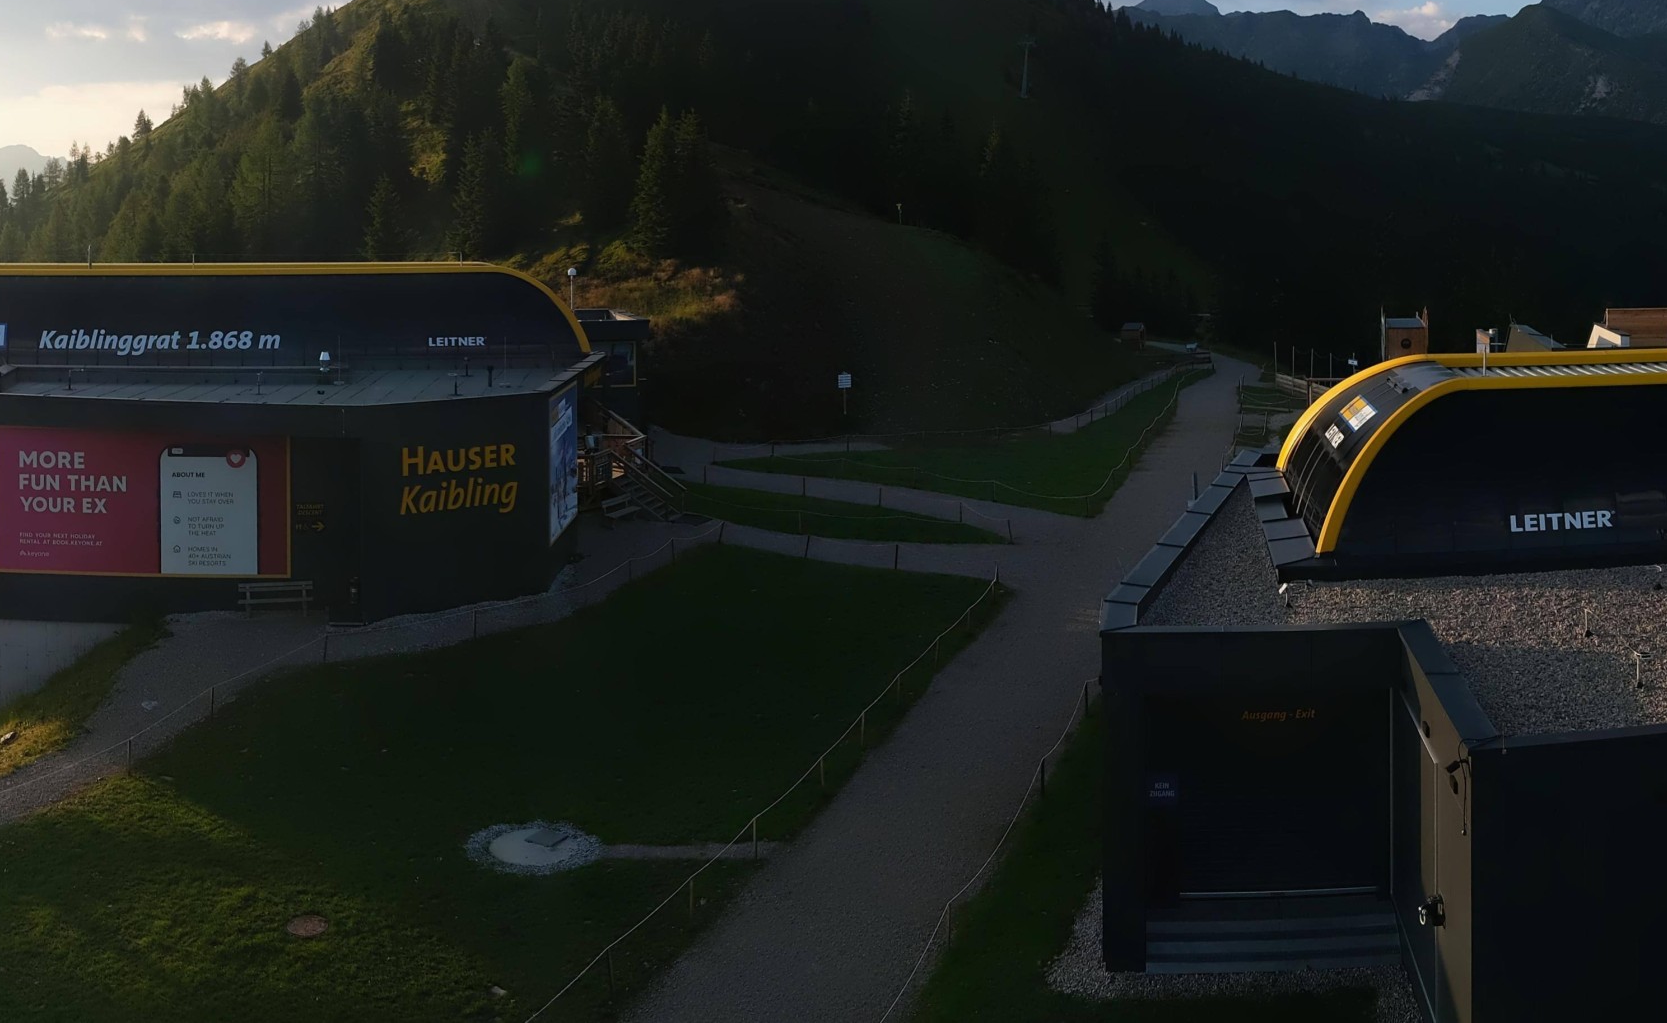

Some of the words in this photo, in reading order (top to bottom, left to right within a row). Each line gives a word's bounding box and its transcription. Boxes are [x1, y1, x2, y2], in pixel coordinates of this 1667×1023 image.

[39, 329, 180, 356] Kaiblinggrat
[186, 331, 253, 349] 1.868
[259, 334, 280, 349] m
[428, 336, 486, 347] LEITNER
[19, 451, 85, 469] MORE
[402, 444, 516, 476] HAUSER
[19, 474, 59, 491] FUN
[67, 475, 127, 492] THAN
[20, 497, 75, 513] YOUR
[82, 498, 107, 513] EX
[400, 477, 518, 515] Kaibling
[1509, 510, 1613, 532] LEITNER
[1241, 711, 1287, 723] Ausgang
[1296, 708, 1315, 719] Exit
